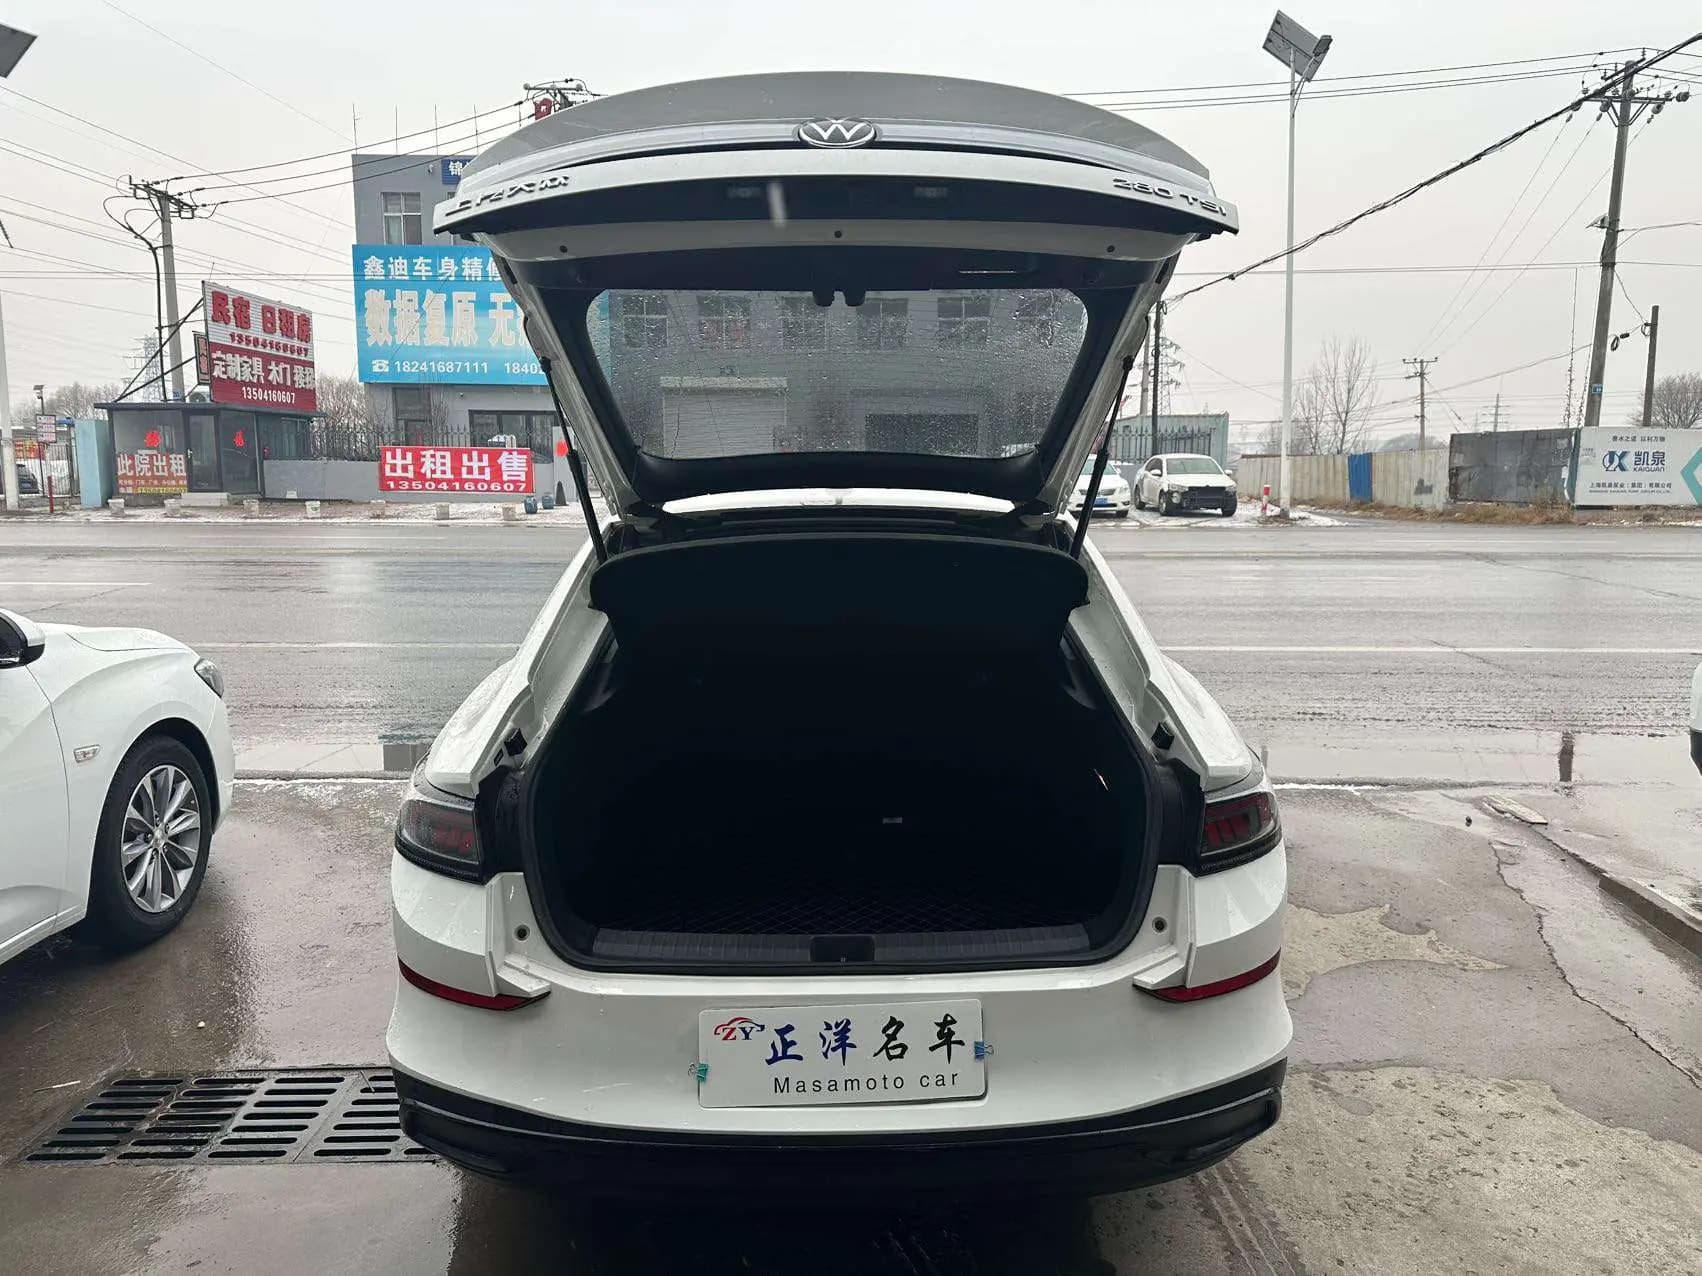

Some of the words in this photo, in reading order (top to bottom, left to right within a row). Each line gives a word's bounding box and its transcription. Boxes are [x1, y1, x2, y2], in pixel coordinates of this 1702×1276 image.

[1113, 178, 1174, 199] 280
[1180, 194, 1227, 217] TSI
[211, 290, 252, 330] 民宿
[261, 304, 311, 344] 日租房
[364, 290, 479, 347] 数据复原
[488, 292, 529, 346] 无
[211, 350, 265, 384] 定制家具
[267, 360, 292, 386] 木门
[394, 360, 488, 374] 18241687111
[242, 386, 296, 405] 13504160607
[117, 453, 187, 477] 此院出租
[384, 448, 528, 482] 出租出售
[1633, 450, 1666, 466] 凯泉
[386, 480, 527, 492] 13504160607
[721, 1025, 754, 1041] ZY
[765, 1013, 966, 1066] 正洋名车
[774, 1075, 905, 1094] Masamoto
[919, 1072, 959, 1089] car
